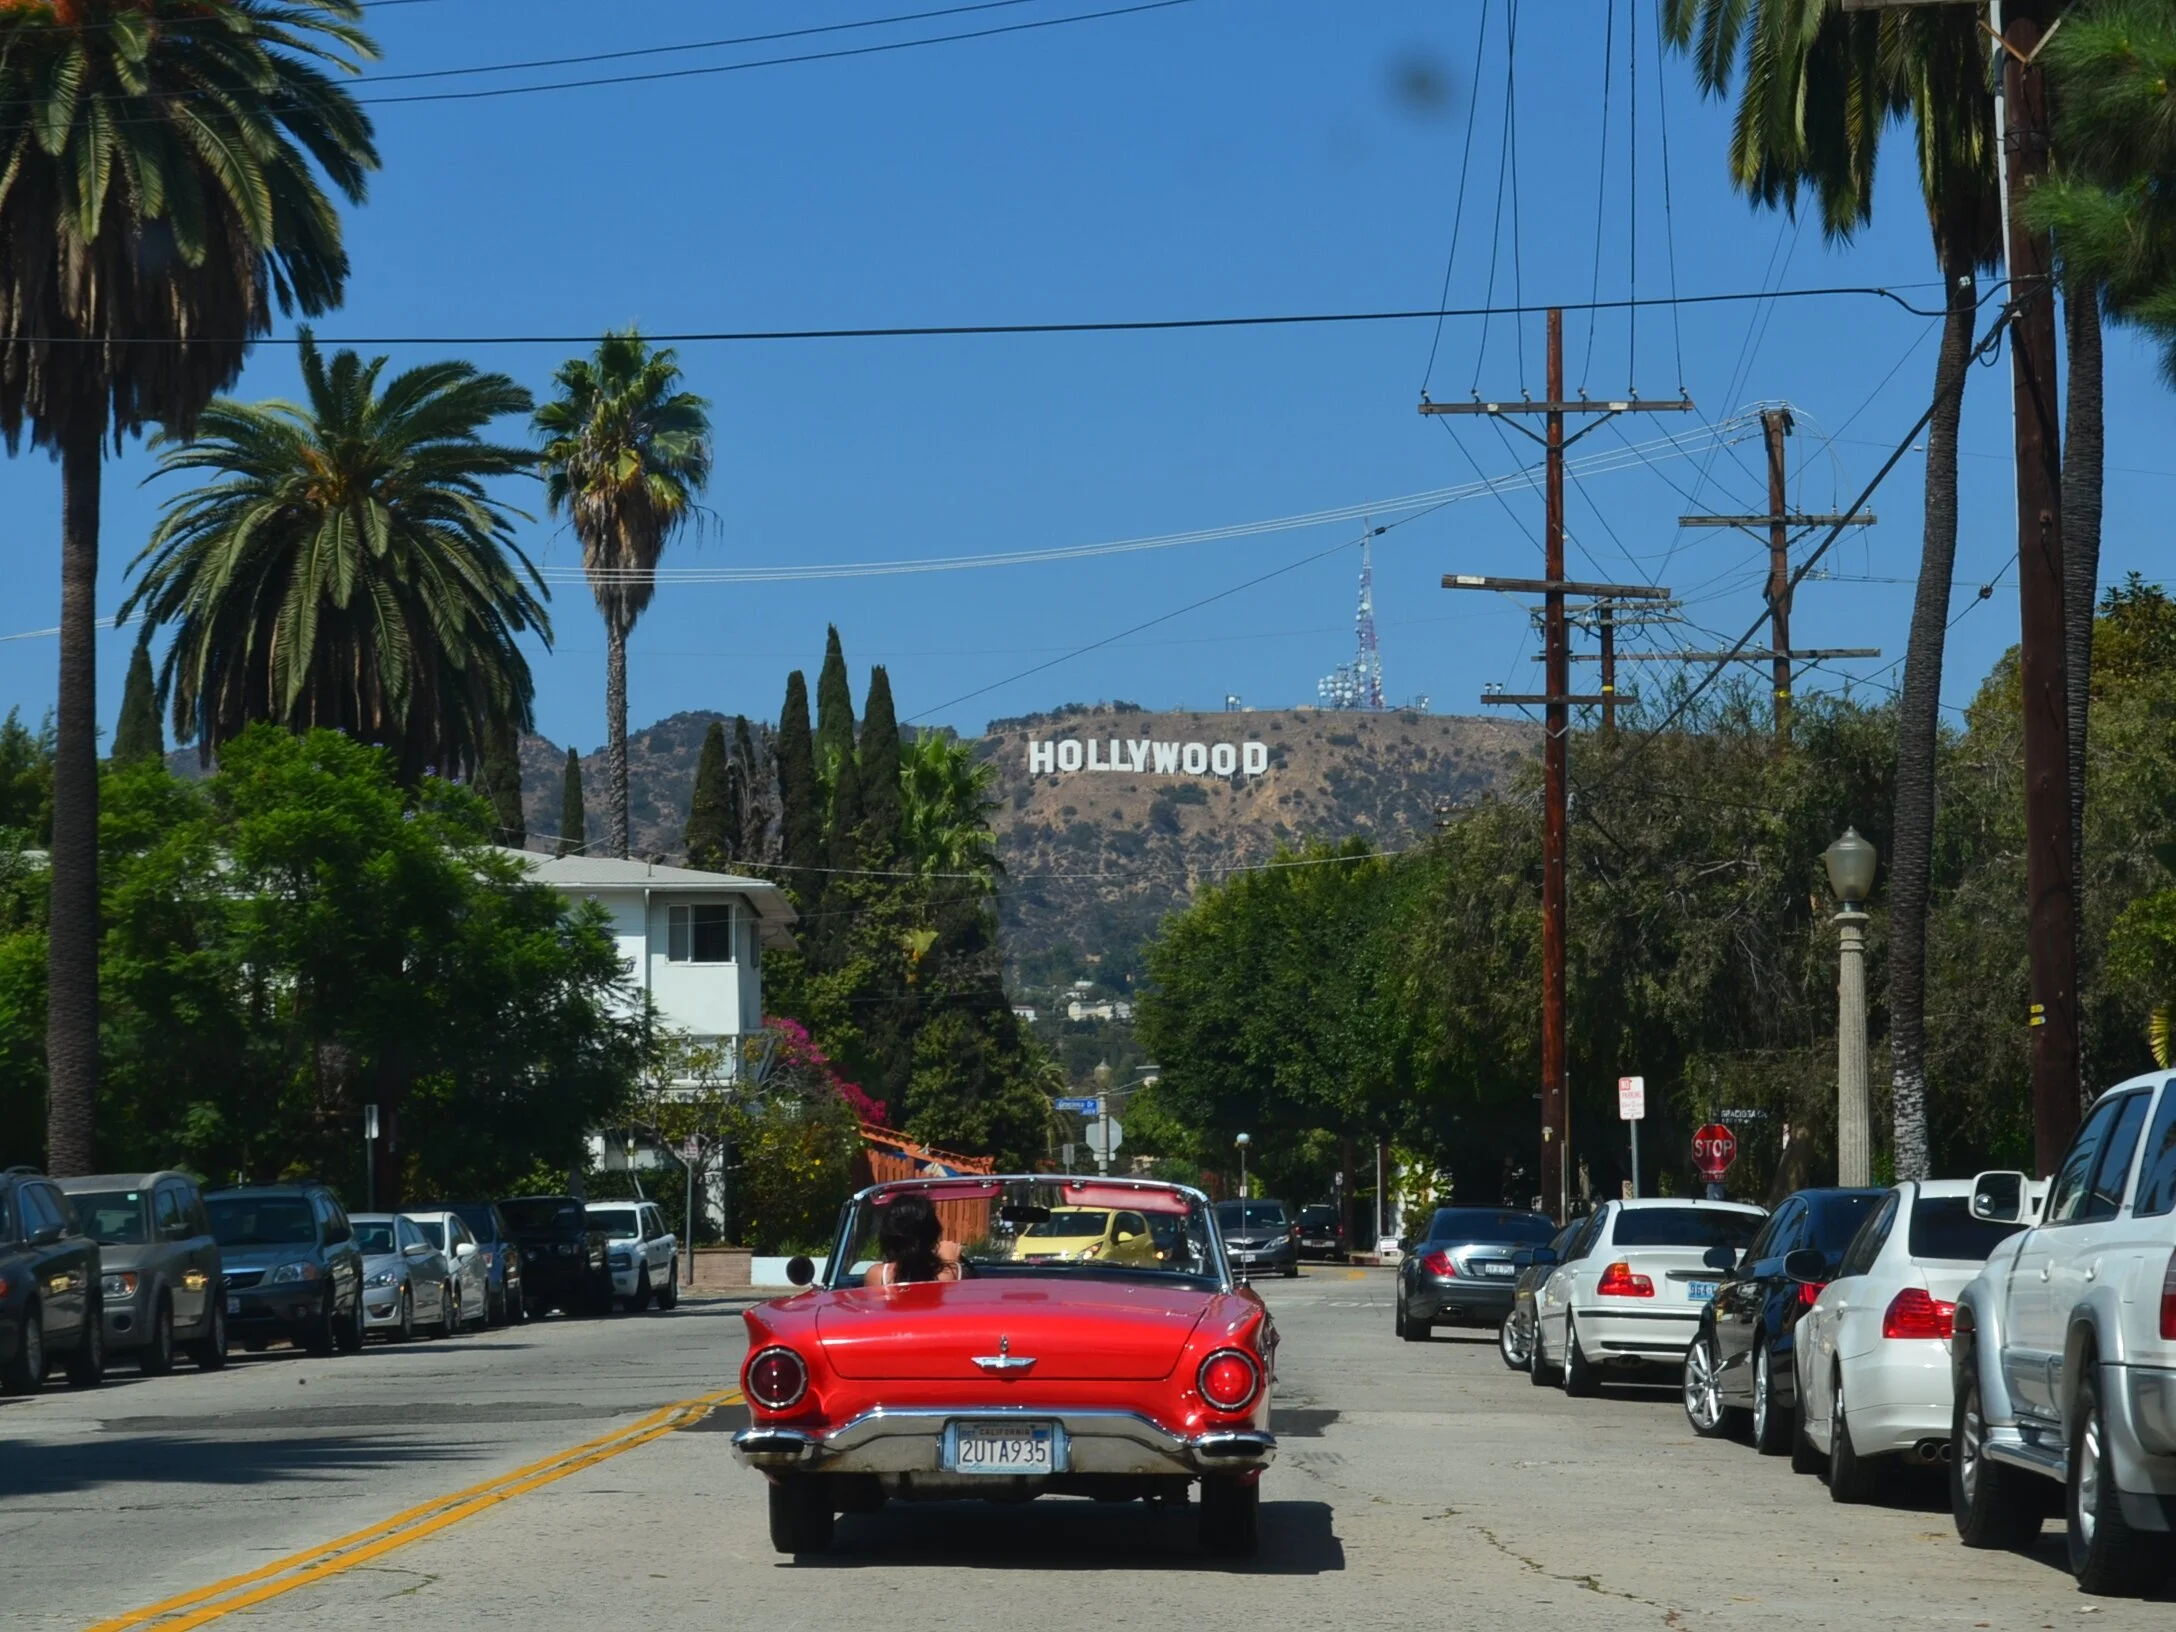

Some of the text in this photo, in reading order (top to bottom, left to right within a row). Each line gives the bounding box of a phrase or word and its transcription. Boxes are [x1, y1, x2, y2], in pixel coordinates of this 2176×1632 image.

[1029, 739, 1268, 775] HOLLYWOOD
[1694, 1139, 1733, 1158] STOP
[979, 1428, 1030, 1437] CALIFORNIA
[962, 1440, 1046, 1463] 2UTA935
